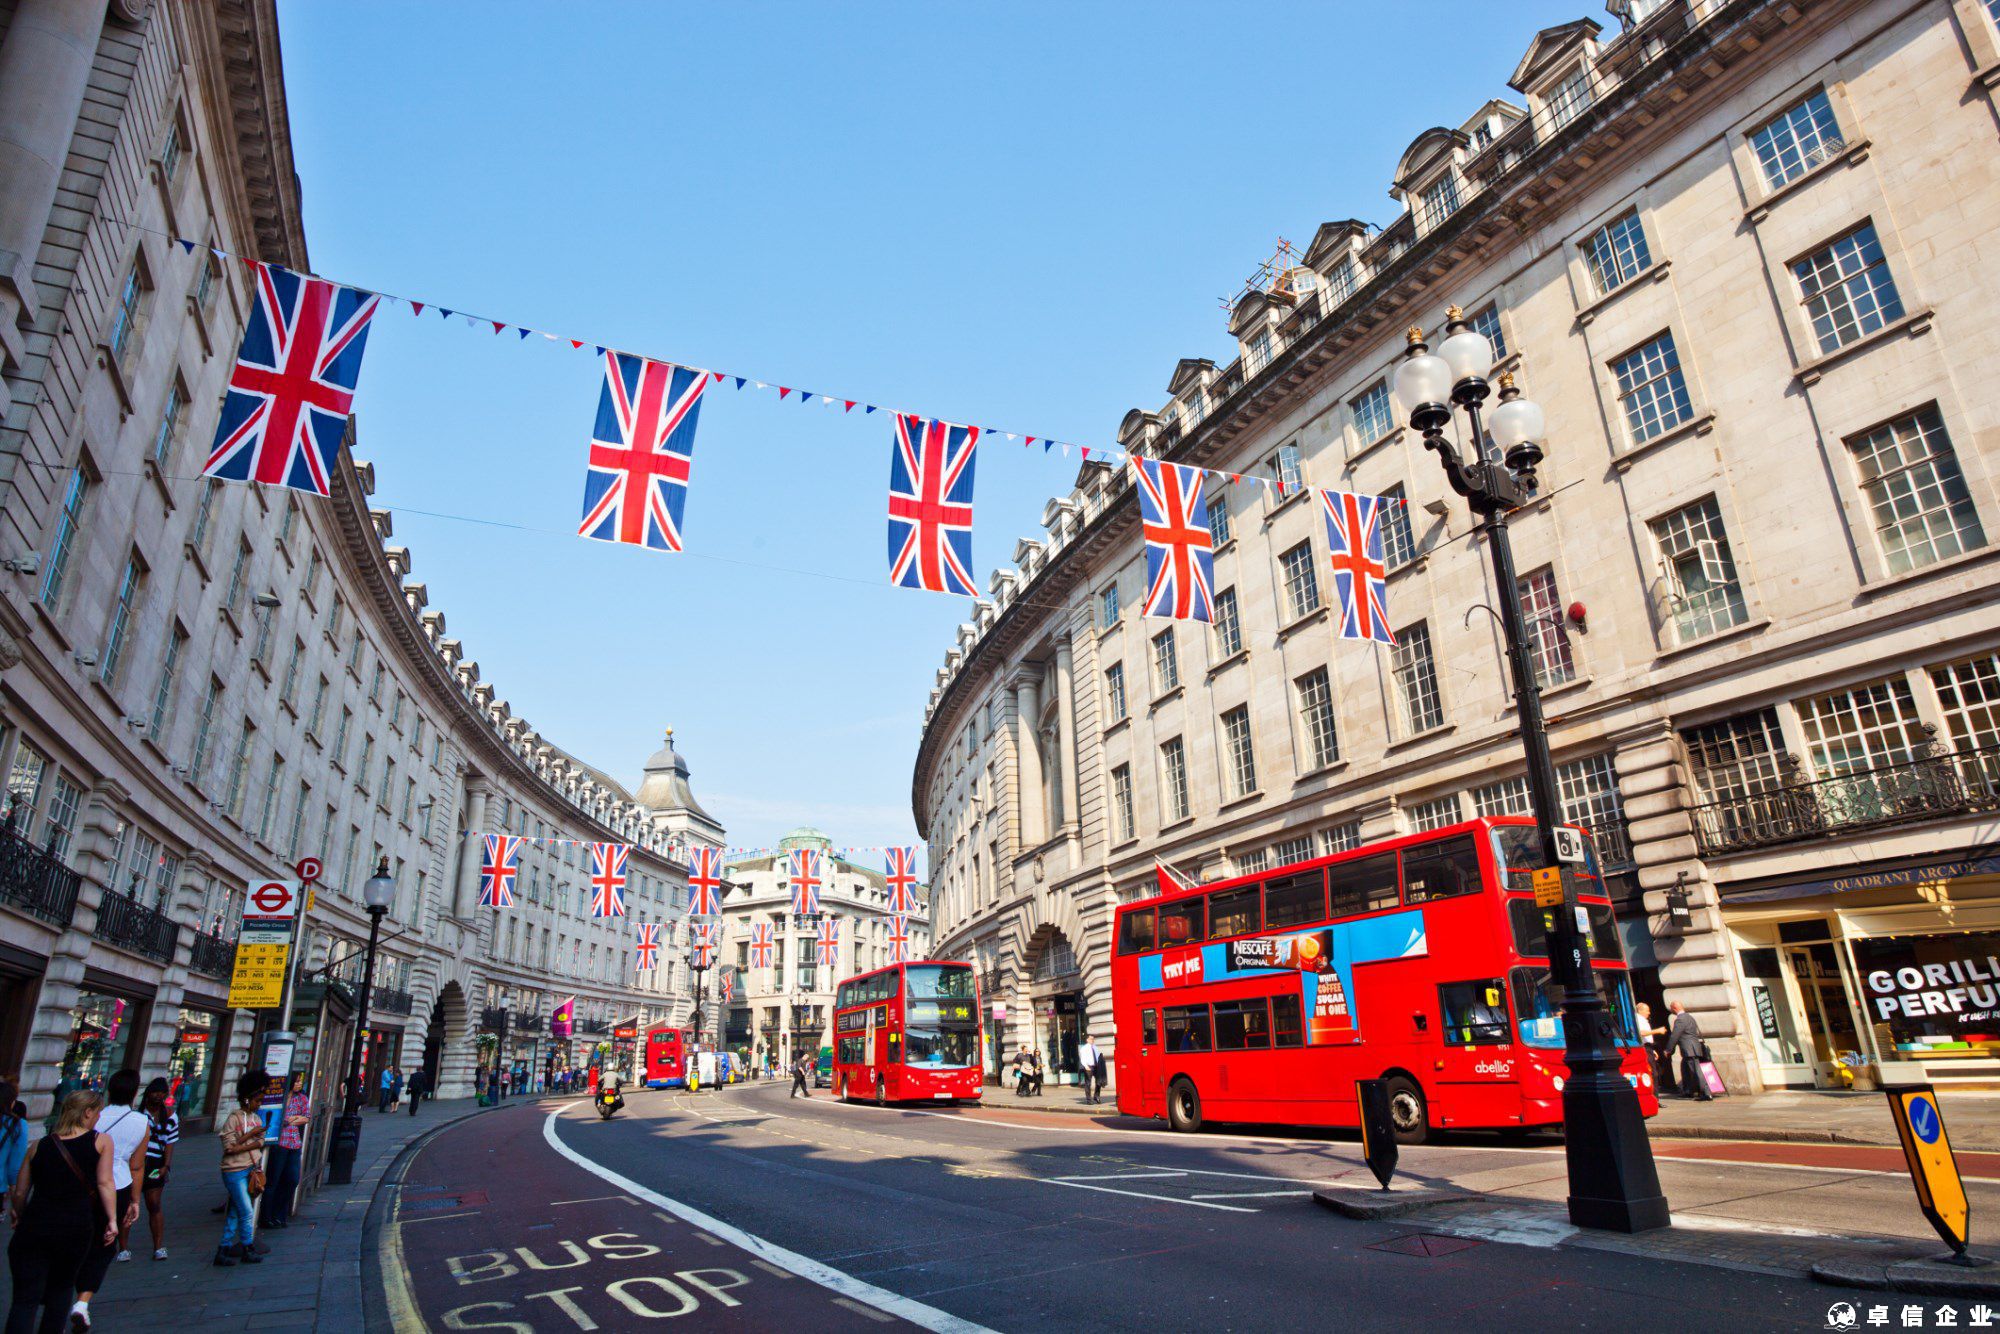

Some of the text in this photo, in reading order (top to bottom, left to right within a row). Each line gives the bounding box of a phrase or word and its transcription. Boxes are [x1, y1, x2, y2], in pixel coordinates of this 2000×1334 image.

[303, 862, 319, 878] D
[1833, 861, 1978, 891] QUADRANT ARCADE
[1233, 940, 1273, 955] NESCAFÉ
[1163, 956, 1201, 979] TRY ME
[1235, 956, 1270, 967] ORIGINAL
[1318, 973, 1338, 983] WHITE
[1317, 983, 1342, 994] COFFEE
[1316, 993, 1344, 1005] SUGAR
[1875, 982, 2000, 1020] PERFU
[955, 1007, 969, 1018] 94
[1315, 1004, 1347, 1017] IN ONE
[1475, 1059, 1510, 1073] abellio
[446, 1233, 662, 1286] BUS
[441, 1268, 753, 1334] STOP
